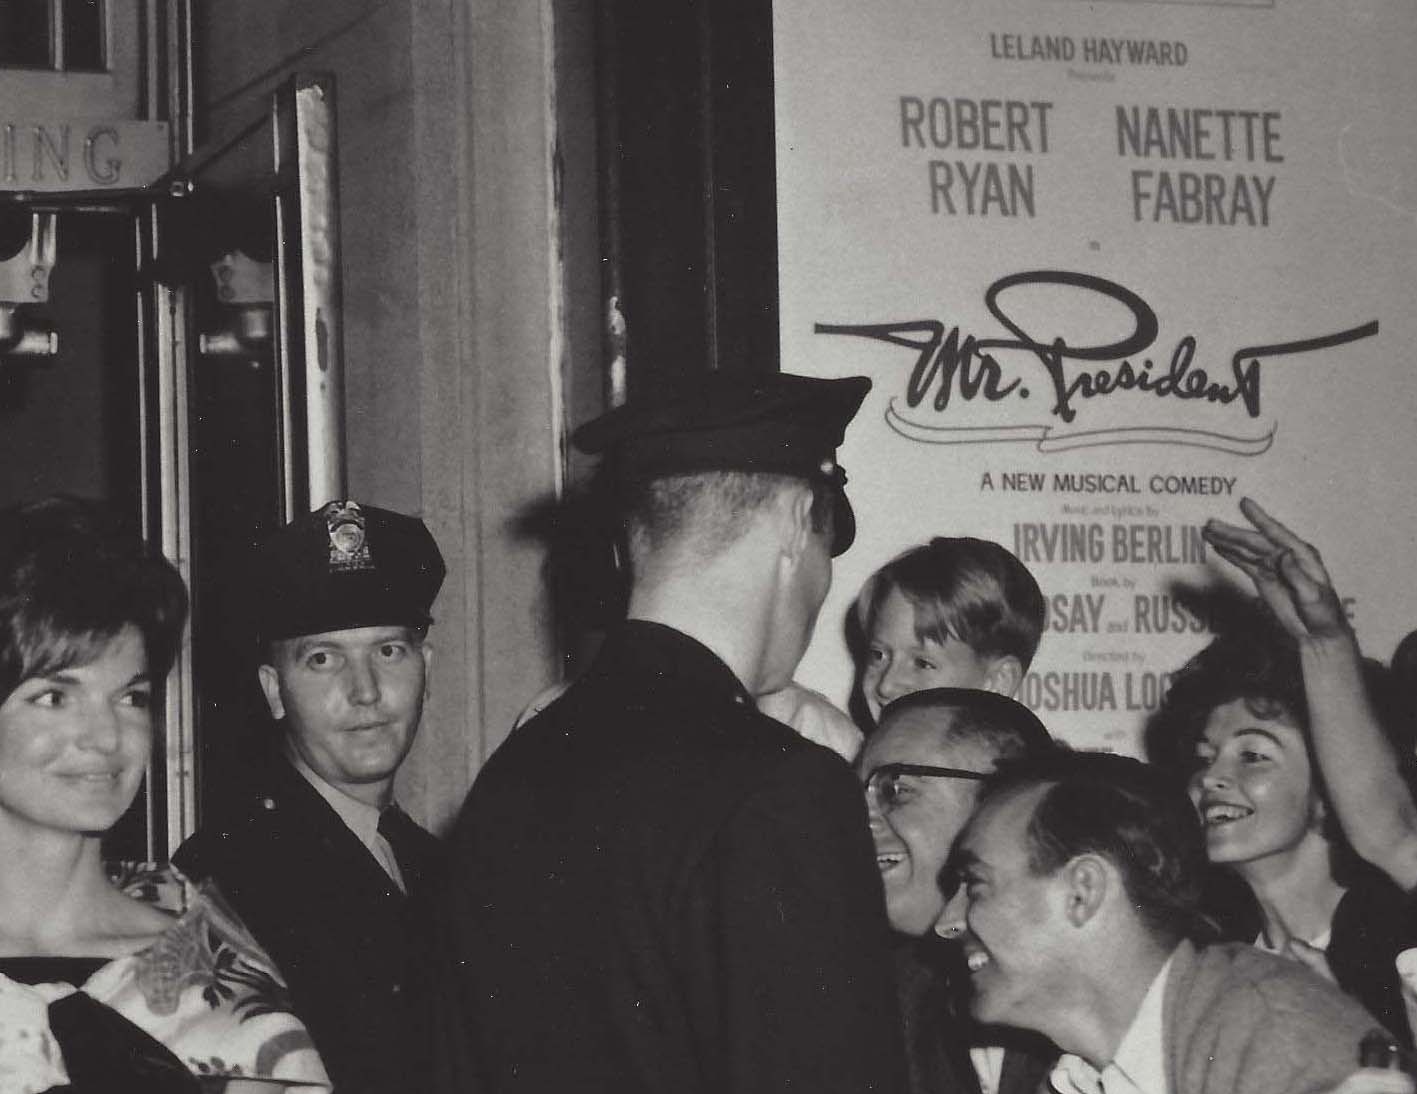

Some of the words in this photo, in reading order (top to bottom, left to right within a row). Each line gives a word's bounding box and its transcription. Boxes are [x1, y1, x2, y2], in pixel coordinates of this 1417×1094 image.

[990, 33, 1075, 62] LELAND
[1084, 37, 1188, 66] HAYWARD
[899, 96, 1053, 154] ROBERT
[1115, 104, 1284, 163] NANETTE
[928, 160, 1036, 218] RYAN
[1131, 170, 1276, 227] FABRAY
[815, 320, 1031, 411] Mr.
[978, 271, 1380, 423] President
[980, 472, 995, 491] A
[1002, 473, 1045, 492] NEW
[1053, 473, 1141, 494] MUSICAL
[1149, 474, 1237, 496] COMEDY
[1013, 523, 1105, 563] IRVING
[1112, 524, 1207, 565] BERLIN
